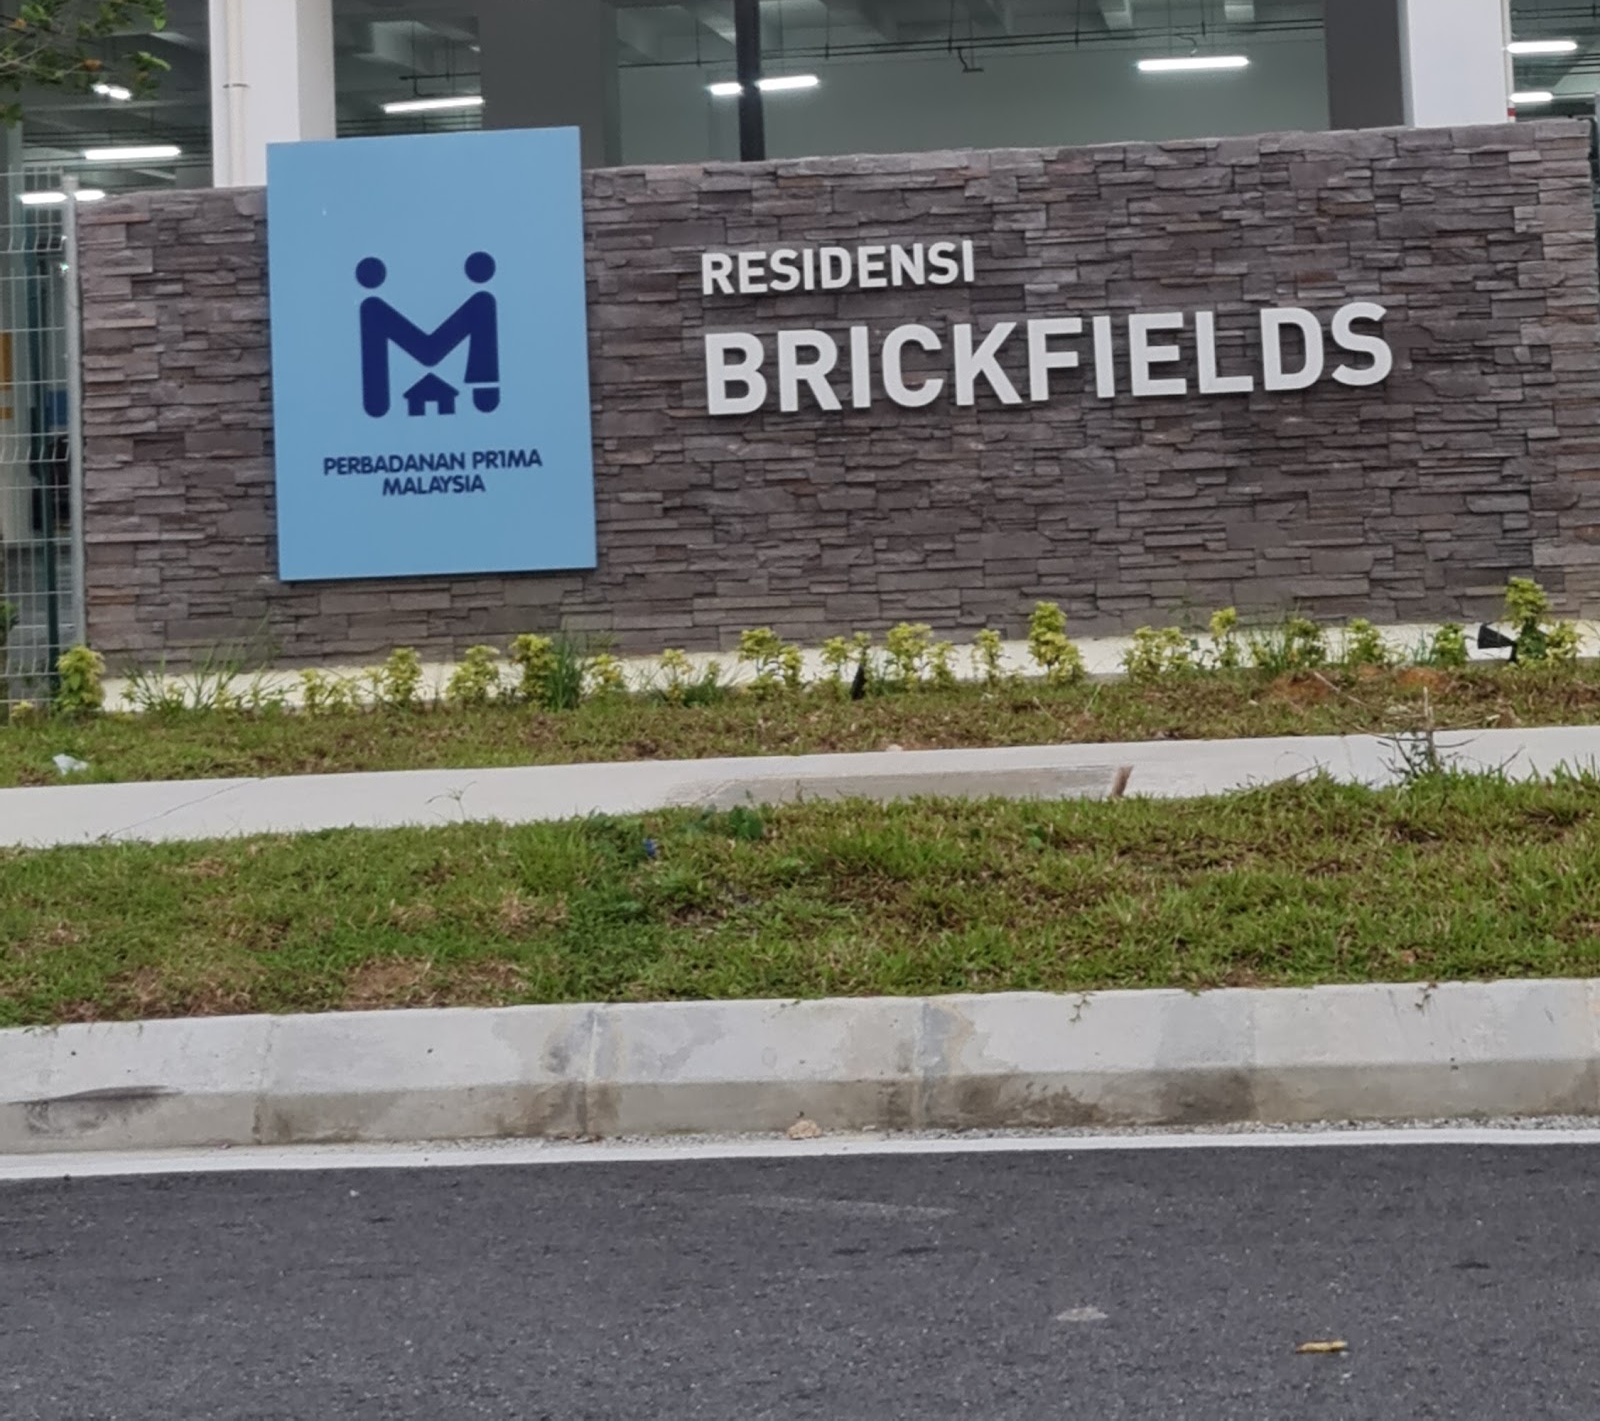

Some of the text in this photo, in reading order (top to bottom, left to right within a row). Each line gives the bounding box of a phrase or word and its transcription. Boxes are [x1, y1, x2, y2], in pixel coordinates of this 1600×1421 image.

[701, 239, 976, 296] RESIDENSI
[704, 301, 1393, 416] BRICKFIELDS
[323, 451, 466, 476] PERBADANAN
[382, 473, 486, 497] MALAYSIA
